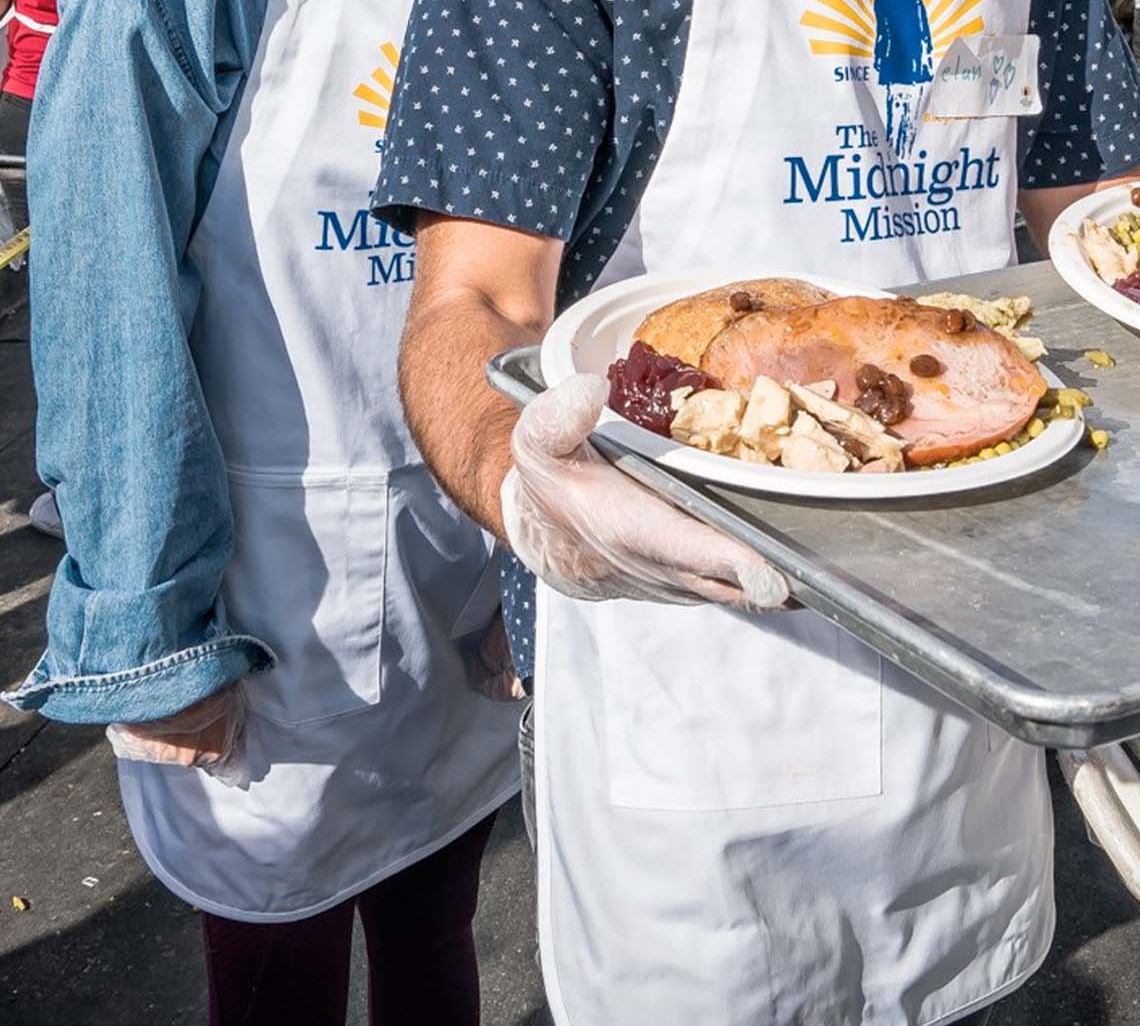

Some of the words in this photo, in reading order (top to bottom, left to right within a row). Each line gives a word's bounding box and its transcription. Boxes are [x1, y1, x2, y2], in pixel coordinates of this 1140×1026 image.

[834, 66, 870, 82] SINCE
[836, 124, 879, 149] The
[783, 147, 1000, 205] Midnight
[840, 203, 961, 243] Mission
